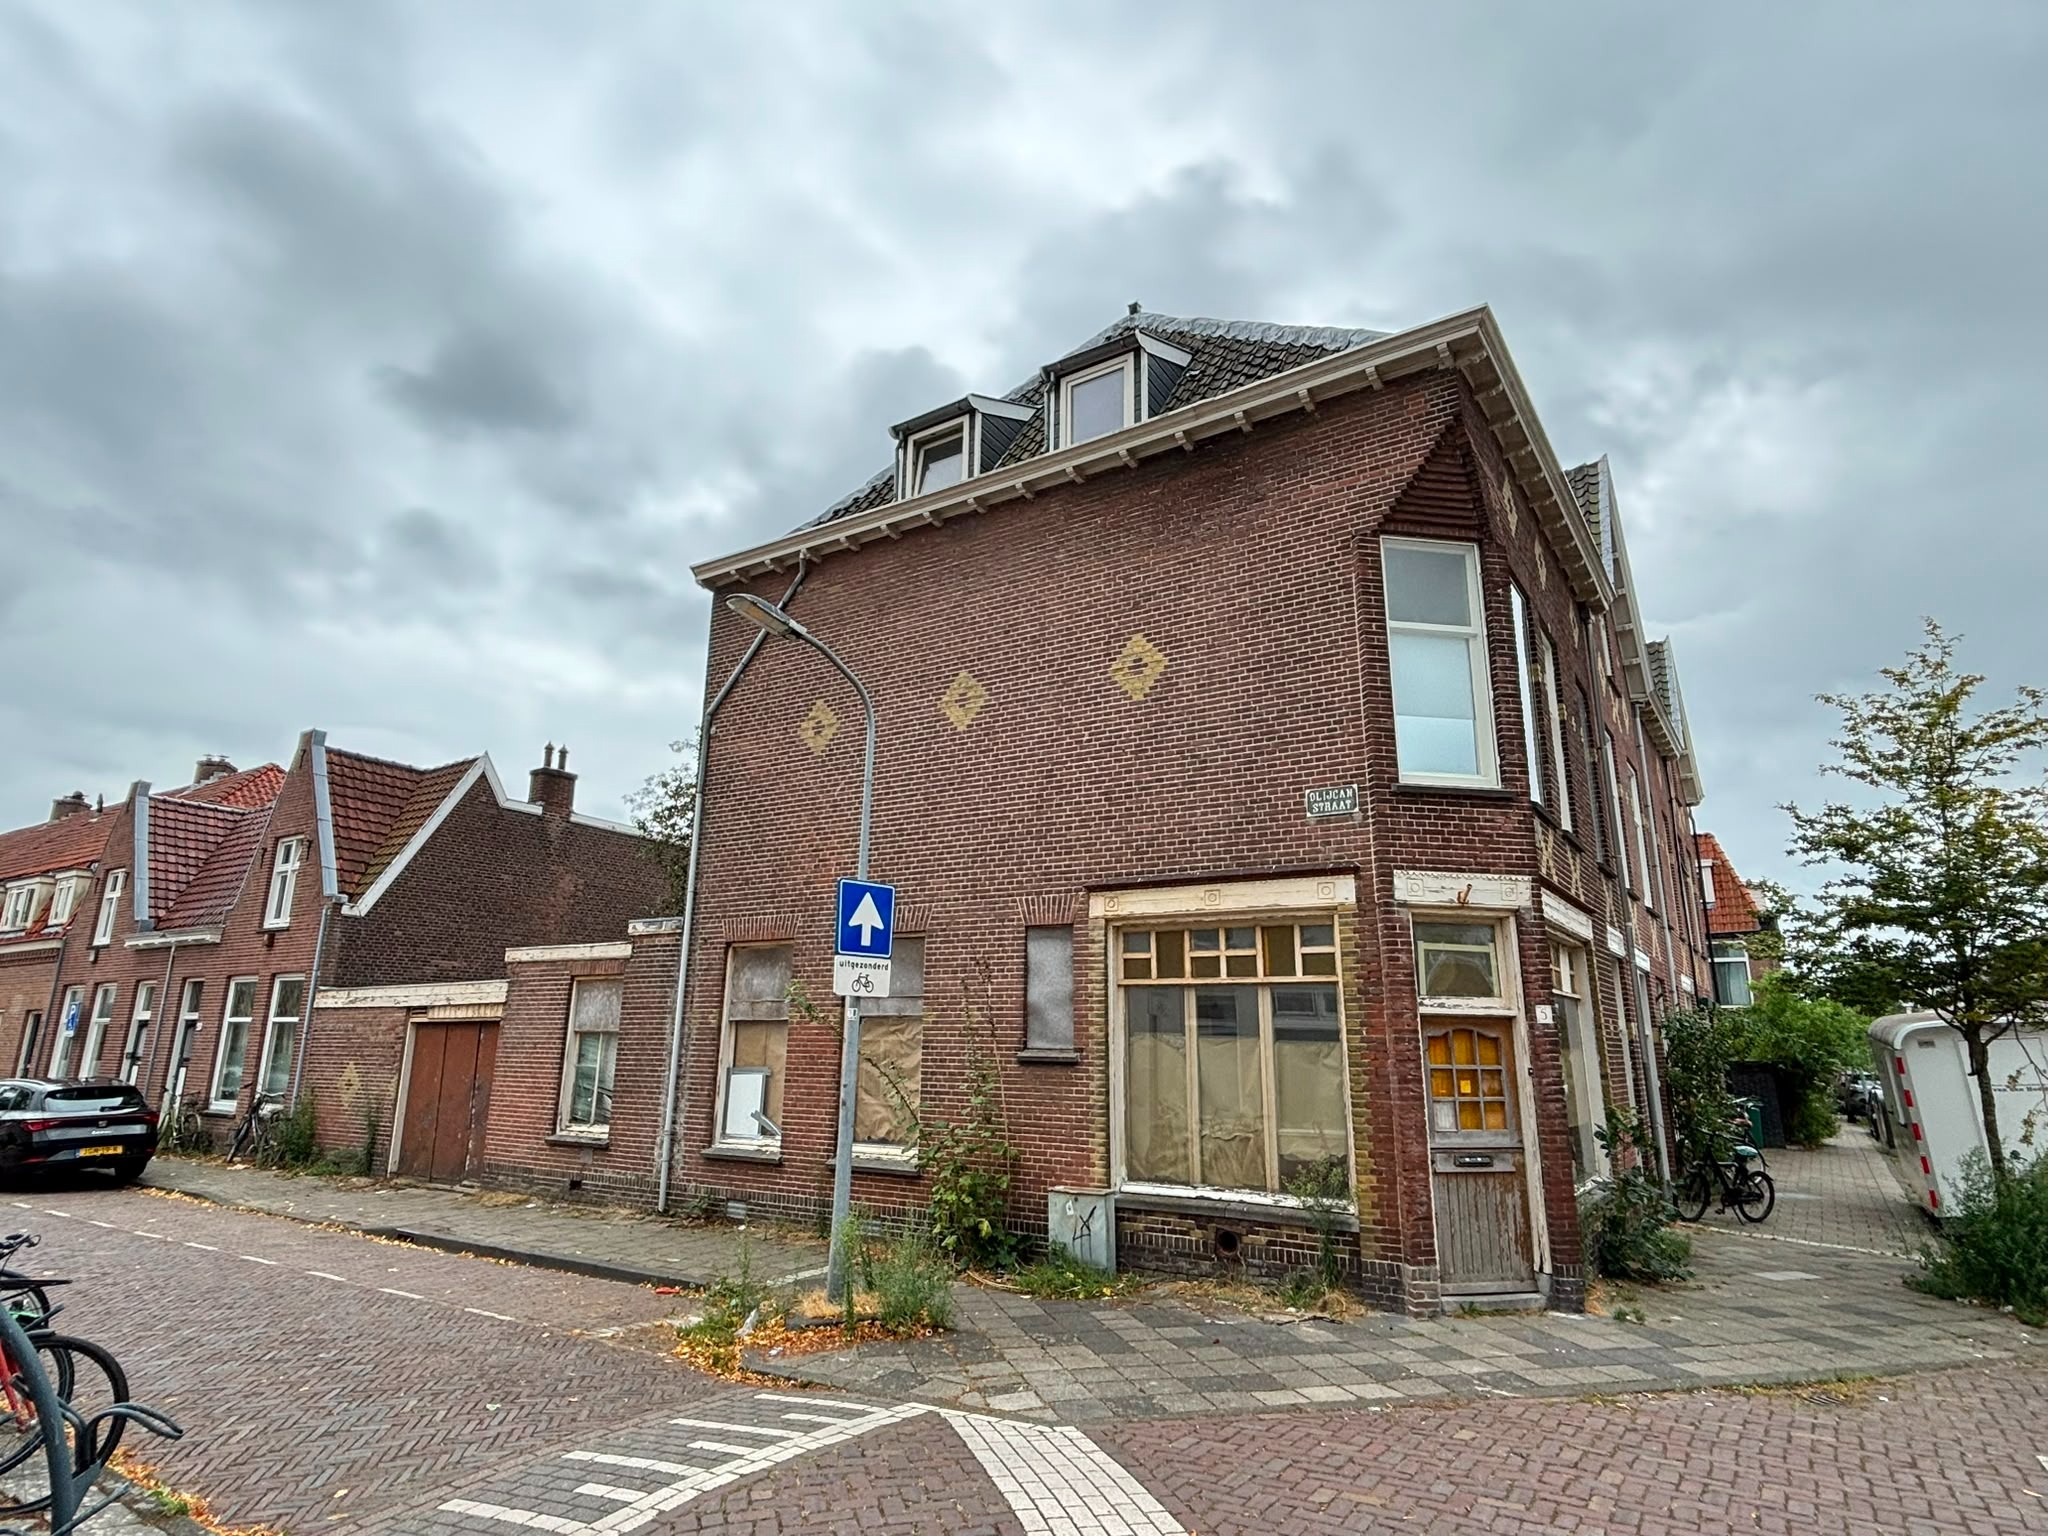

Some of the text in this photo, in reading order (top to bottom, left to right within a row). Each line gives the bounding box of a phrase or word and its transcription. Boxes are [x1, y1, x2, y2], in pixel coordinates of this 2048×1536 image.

[1309, 788, 1353, 802] OLIJCAN
[1312, 800, 1352, 813] STRAAT
[839, 960, 889, 971] uitgezonderd
[1540, 1007, 1548, 1021] 5
